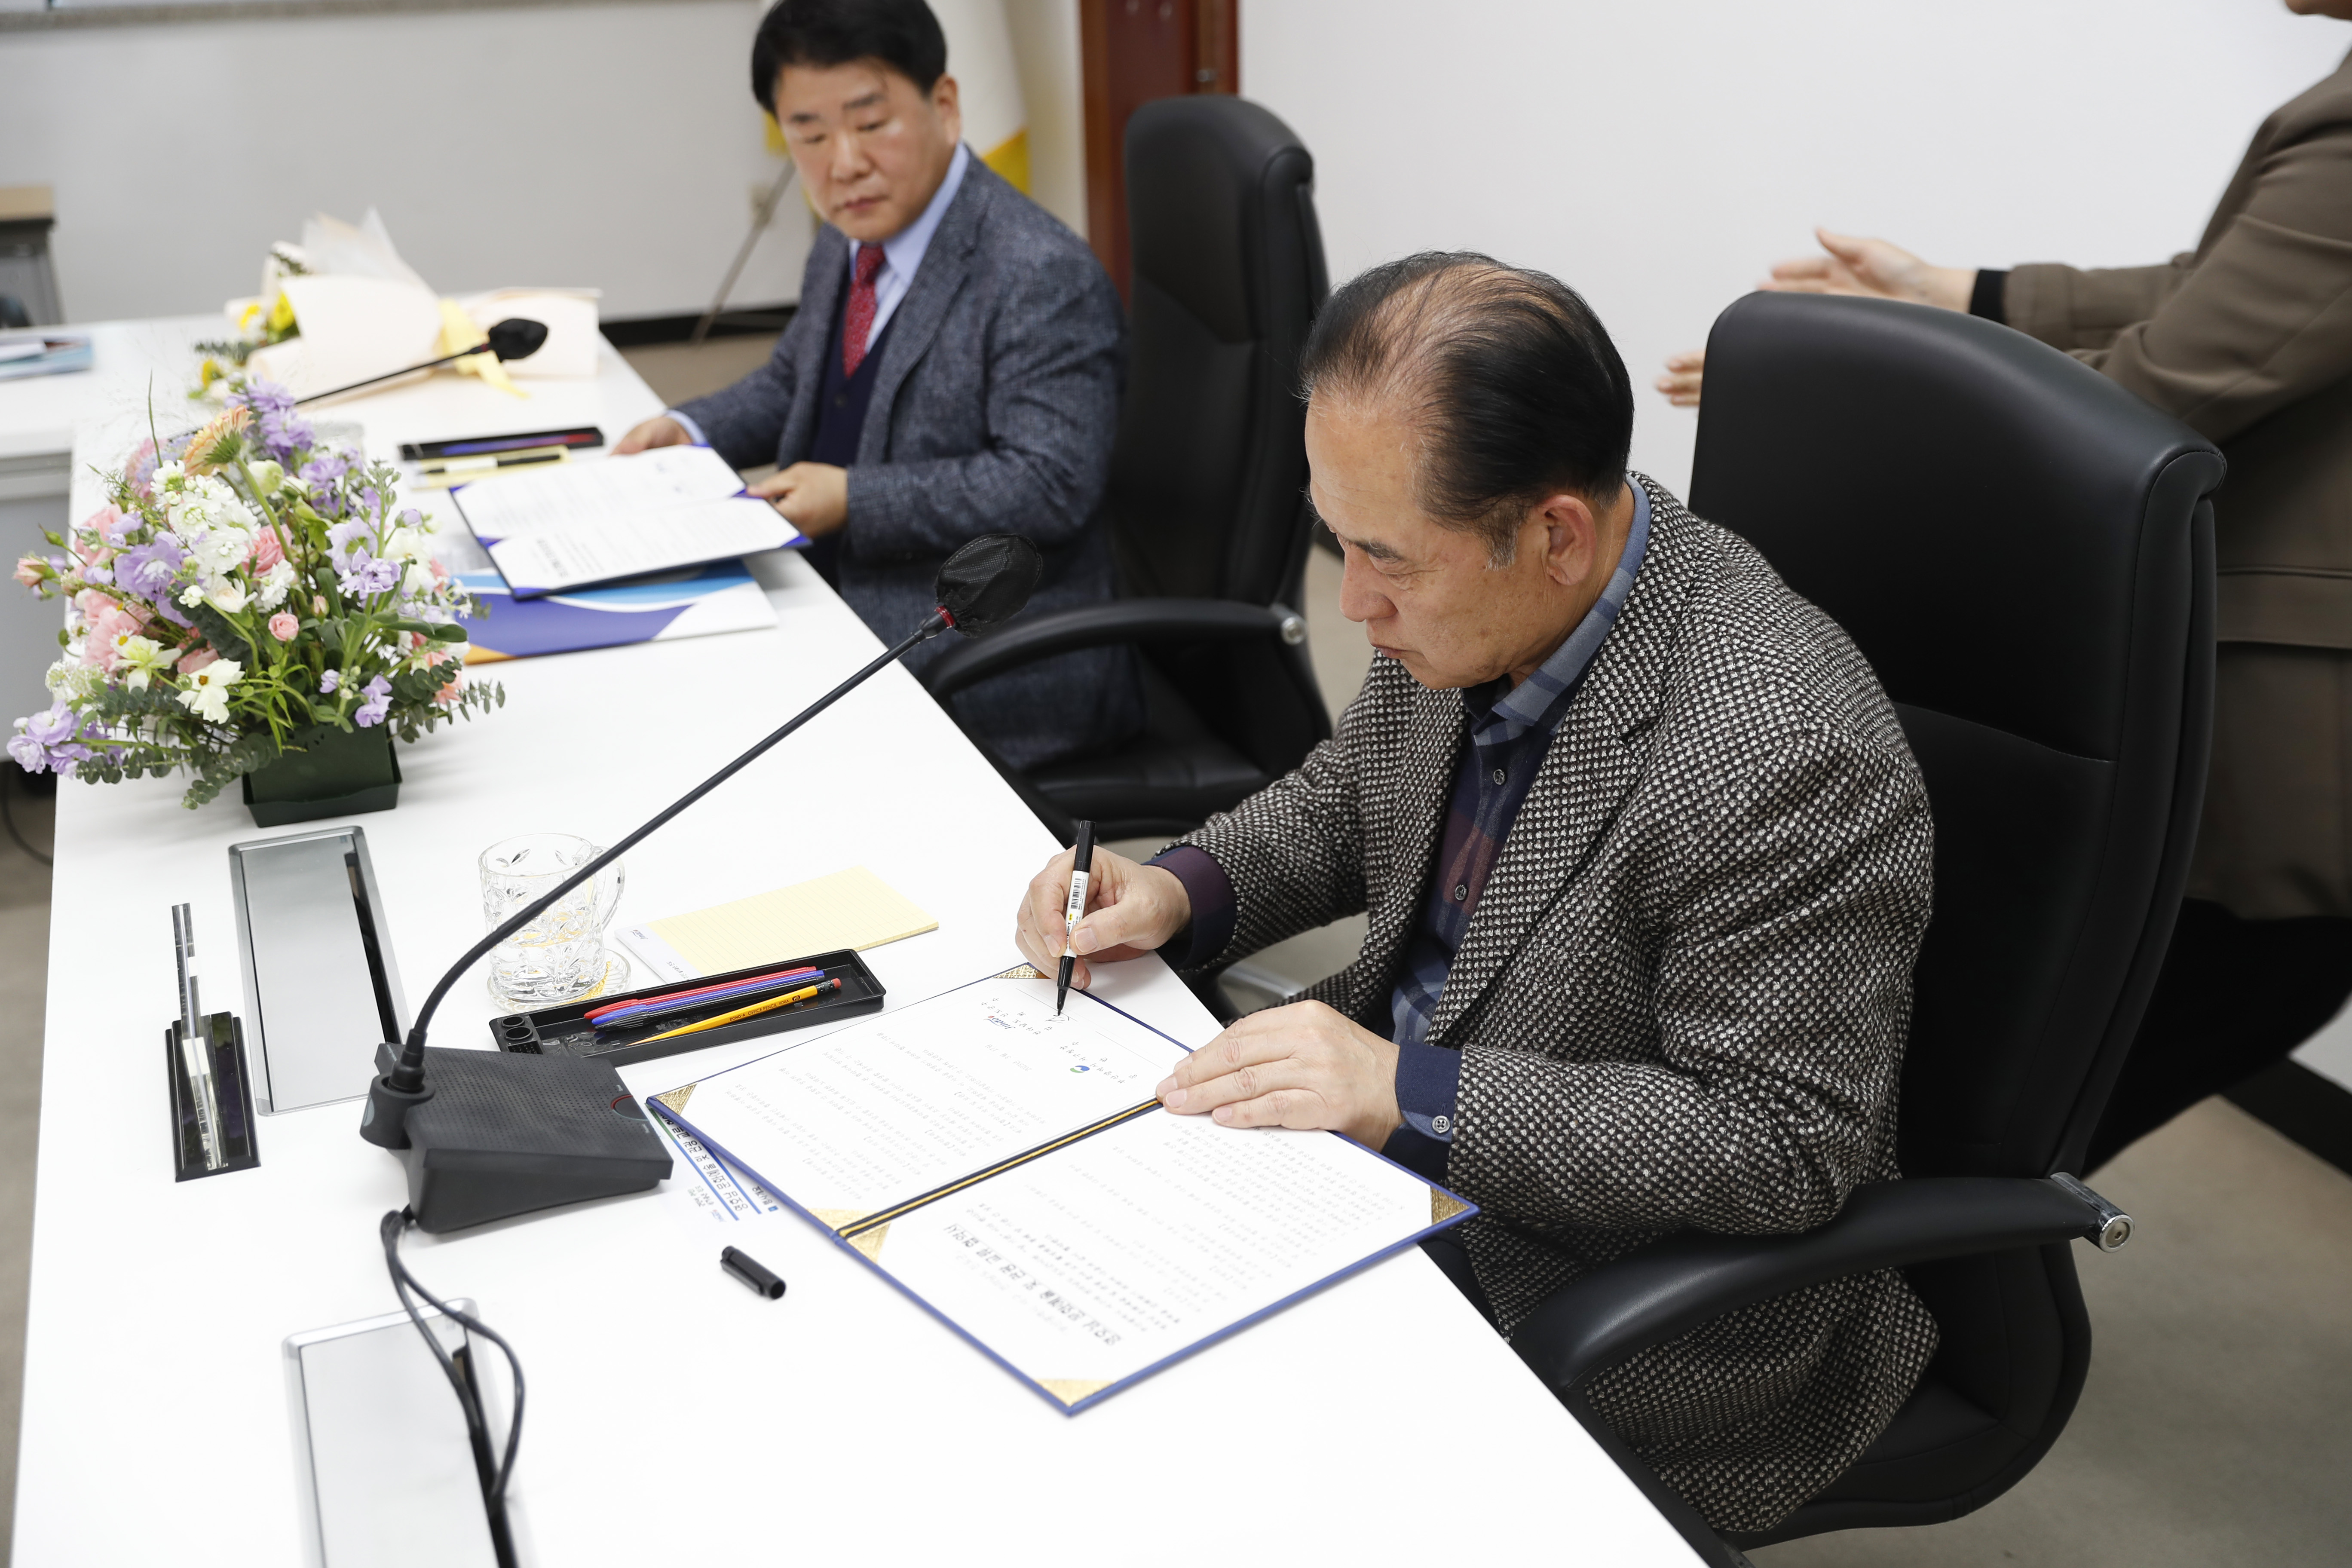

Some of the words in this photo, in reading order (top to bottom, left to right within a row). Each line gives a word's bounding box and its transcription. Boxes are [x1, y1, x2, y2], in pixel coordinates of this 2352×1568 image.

[989, 1017, 1016, 1029] Jindo
[984, 1044, 998, 1052] 17일
[1012, 1060, 1032, 1072] 2023년
[683, 1140, 702, 1153] 관광
[694, 1154, 710, 1162] 및
[703, 1163, 731, 1190] 문화예술
[723, 1191, 748, 1212] 영호남
[752, 1185, 773, 1205] 행사개요
[944, 1223, 979, 1247] 협약서
[976, 1247, 1001, 1264] 교류
[999, 1263, 1026, 1280] 관광
[1023, 1279, 1040, 1290] 및
[1040, 1290, 1085, 1320] 문화예술
[1083, 1320, 1121, 1345] 영호남
